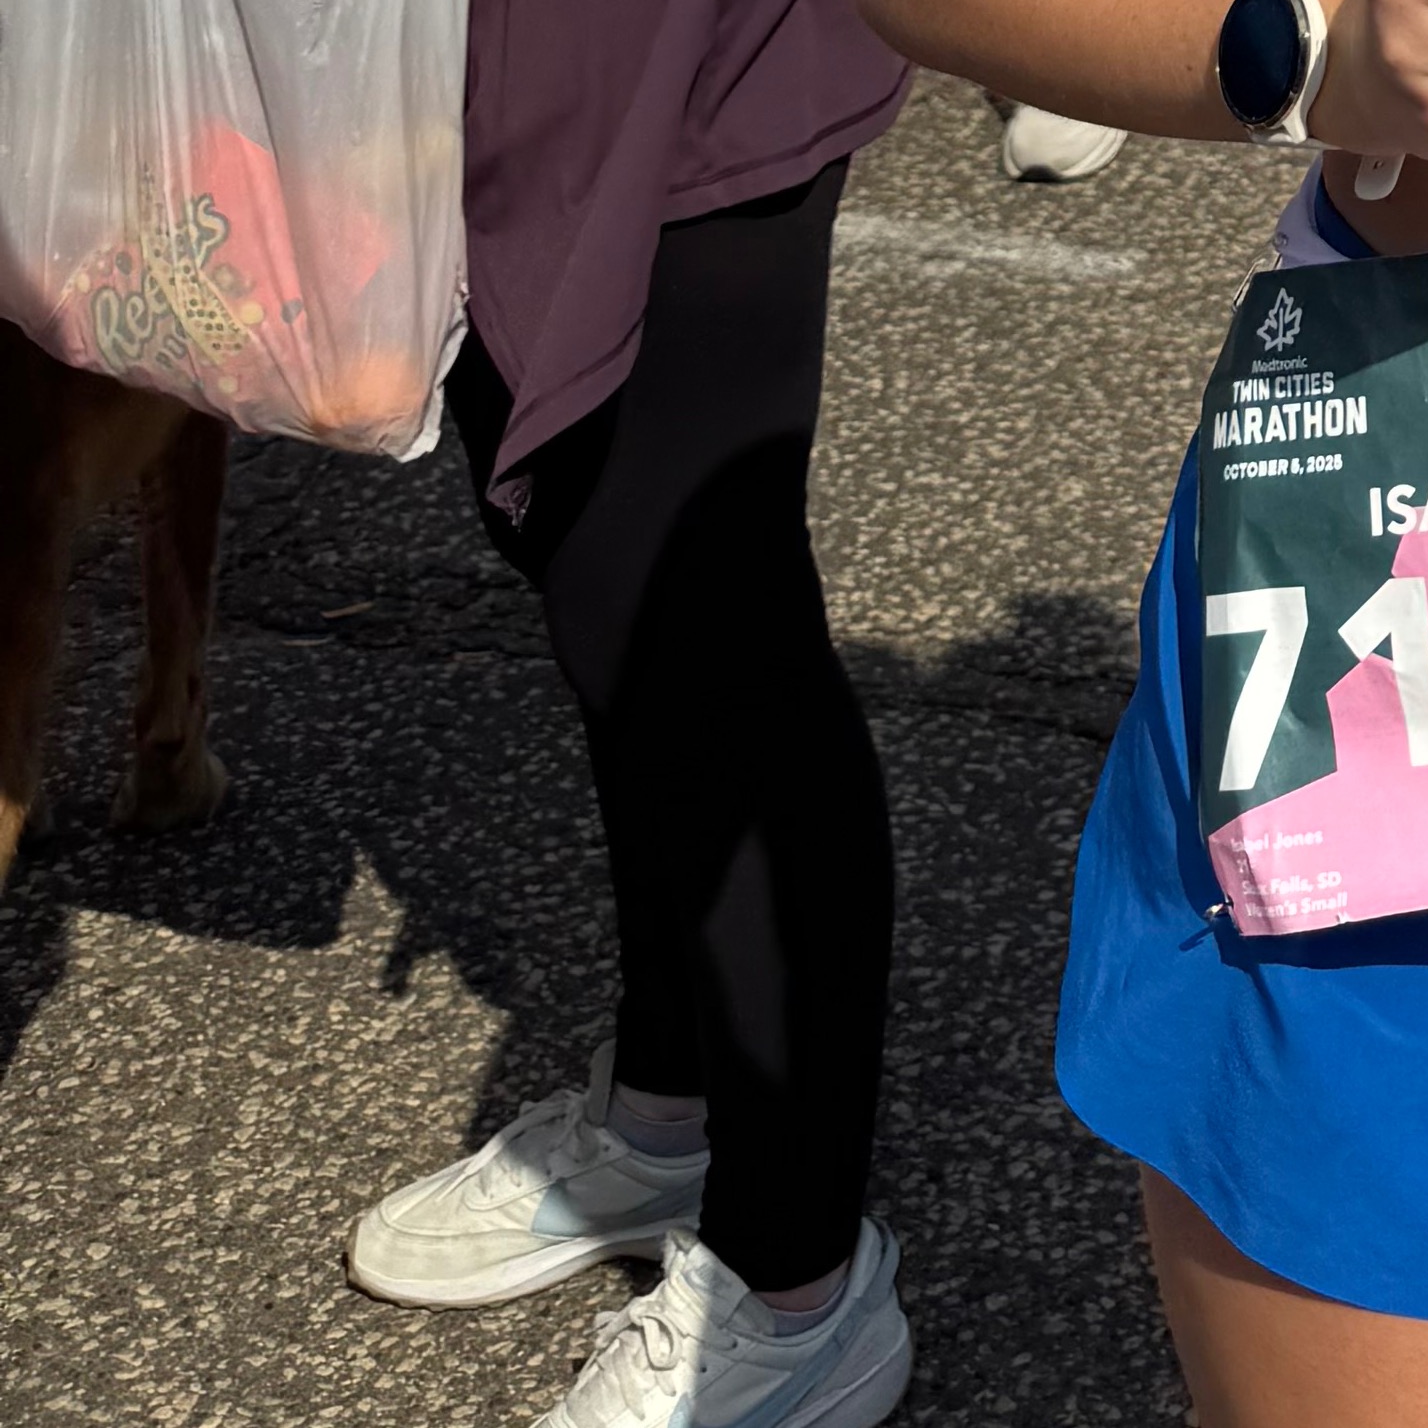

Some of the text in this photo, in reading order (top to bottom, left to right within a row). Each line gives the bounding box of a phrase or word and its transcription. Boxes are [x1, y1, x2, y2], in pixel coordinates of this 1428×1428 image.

[1252, 355, 1309, 374] Medtronic
[1233, 371, 1335, 404] TWIN CITIES
[1213, 396, 1368, 450] MARATHON
[1224, 458, 1289, 481] OCTOBER
[1273, 830, 1324, 851] Jones
[1317, 871, 1343, 890] SD
[1300, 892, 1348, 915] Small
